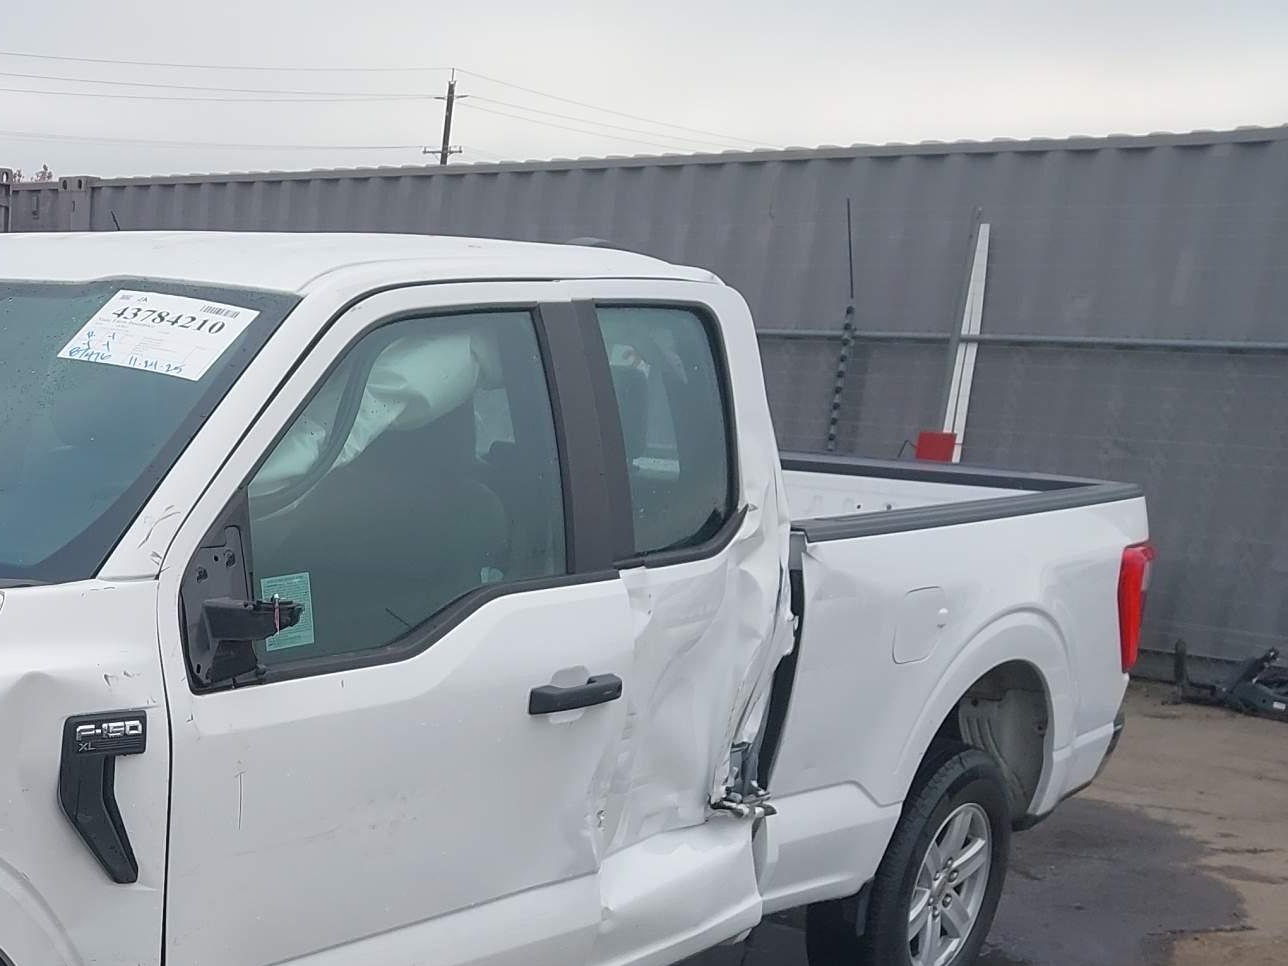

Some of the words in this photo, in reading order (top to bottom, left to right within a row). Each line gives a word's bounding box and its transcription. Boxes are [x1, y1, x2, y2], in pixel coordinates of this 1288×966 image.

[111, 305, 226, 335] 43784210
[75, 719, 143, 742] F-150
[78, 742, 97, 752] XL
